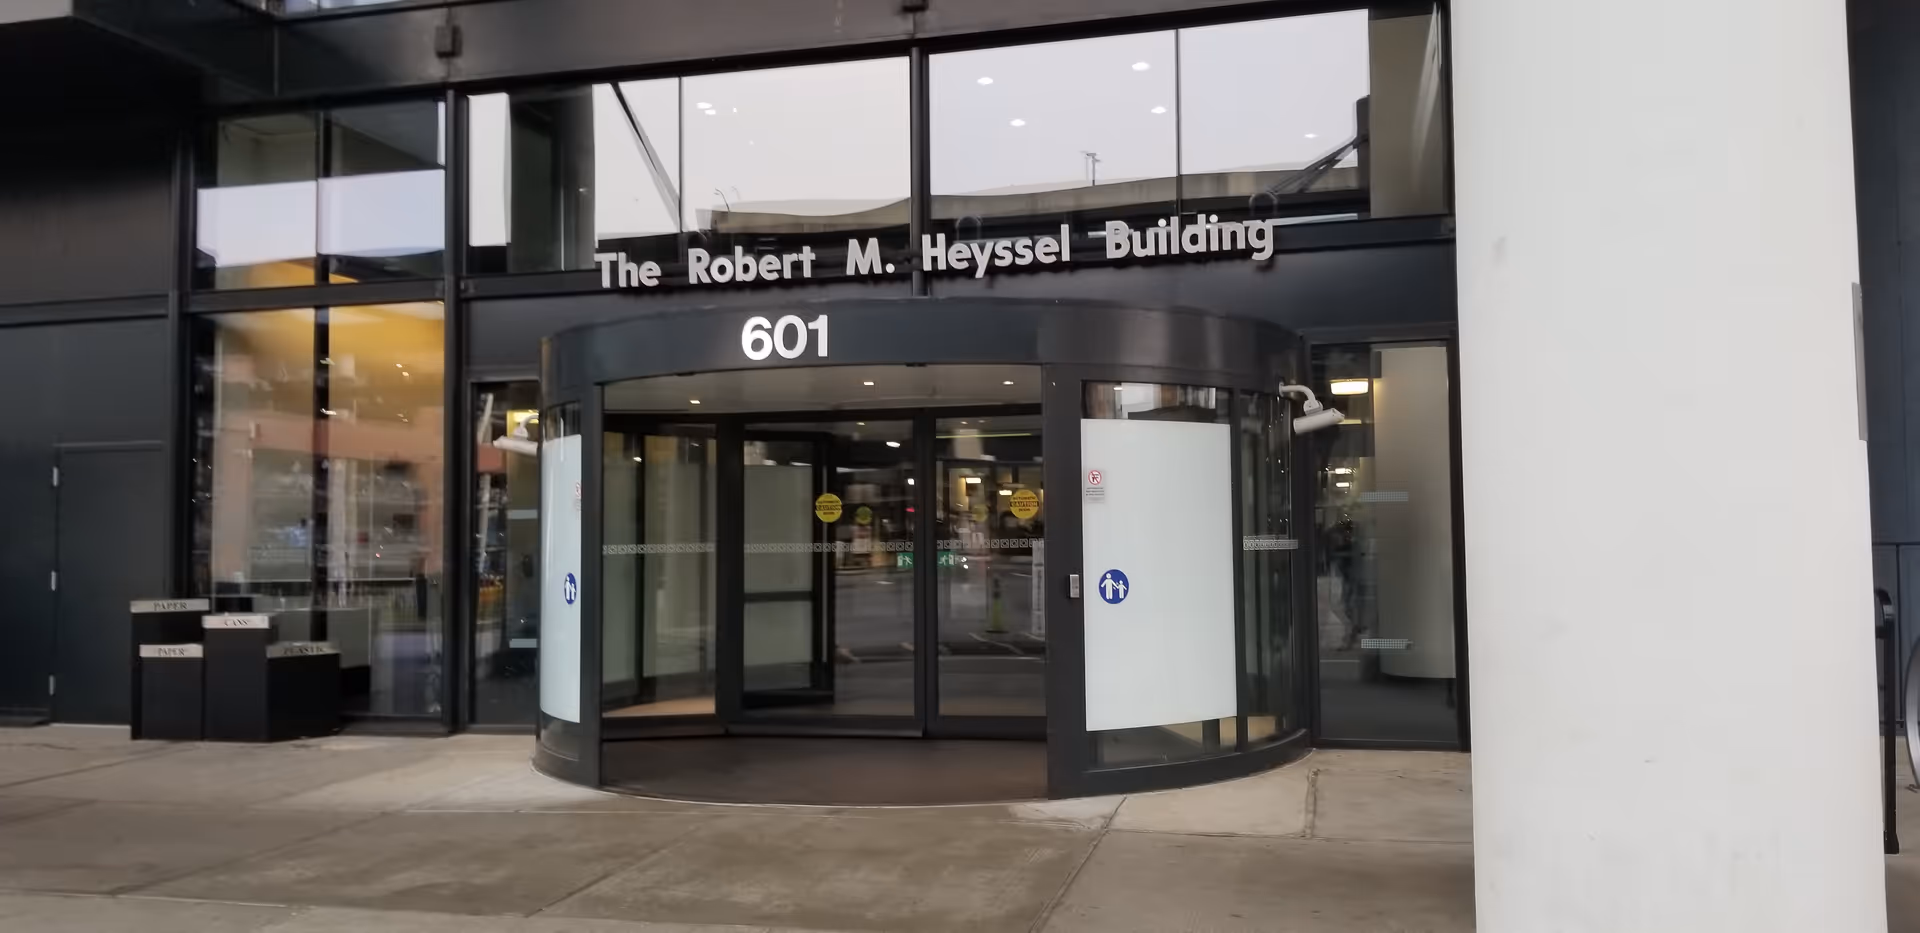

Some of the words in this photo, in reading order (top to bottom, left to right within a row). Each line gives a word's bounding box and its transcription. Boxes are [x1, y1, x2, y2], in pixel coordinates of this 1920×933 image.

[594, 251, 662, 289] The
[688, 245, 816, 285] Robert
[846, 237, 895, 276] M.
[922, 224, 1071, 278] Heyssel
[1105, 213, 1274, 261] Building
[741, 314, 828, 361] 601
[153, 601, 188, 611] PAPER
[158, 647, 185, 657] PAPER
